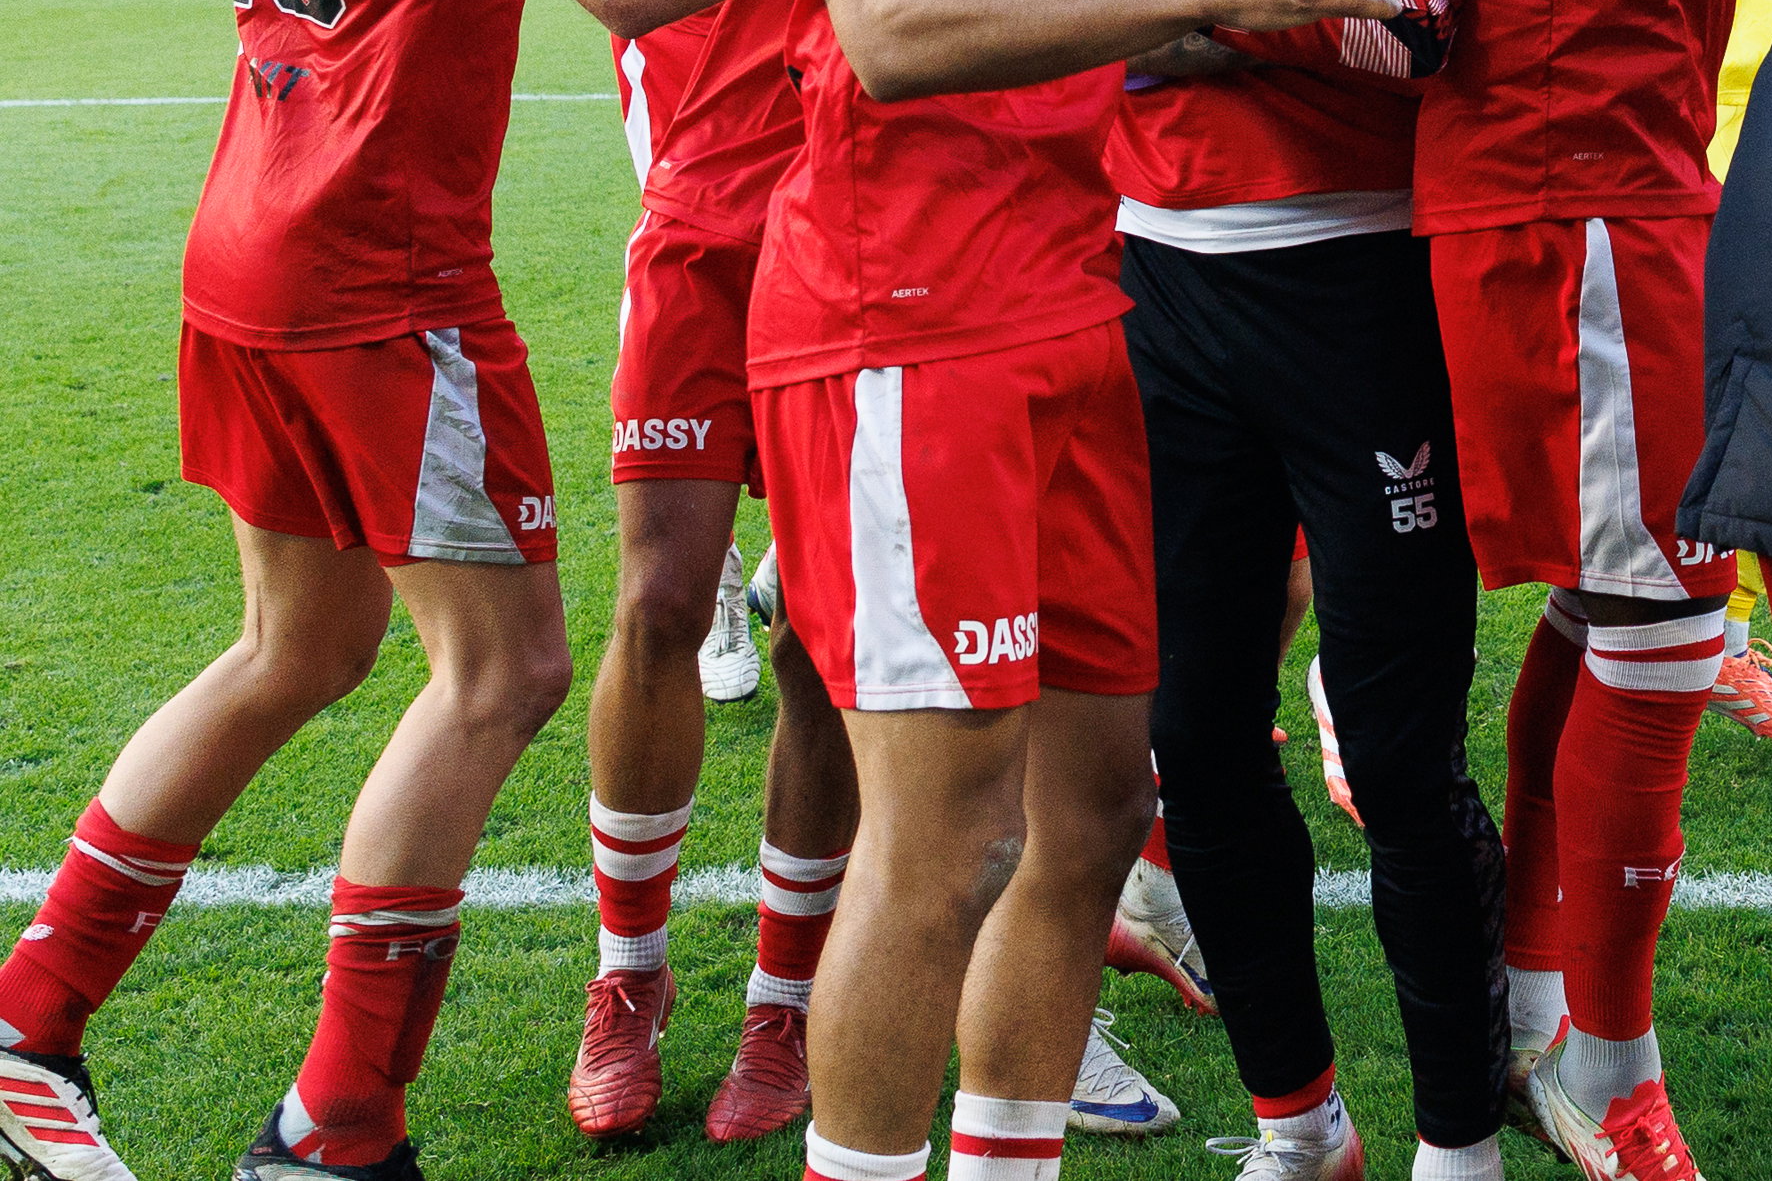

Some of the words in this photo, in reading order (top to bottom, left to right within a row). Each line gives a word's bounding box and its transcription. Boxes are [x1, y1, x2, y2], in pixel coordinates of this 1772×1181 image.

[1384, 477, 1435, 495] CASTORE
[1391, 492, 1438, 534] 55
[953, 611, 1038, 665] DASS
